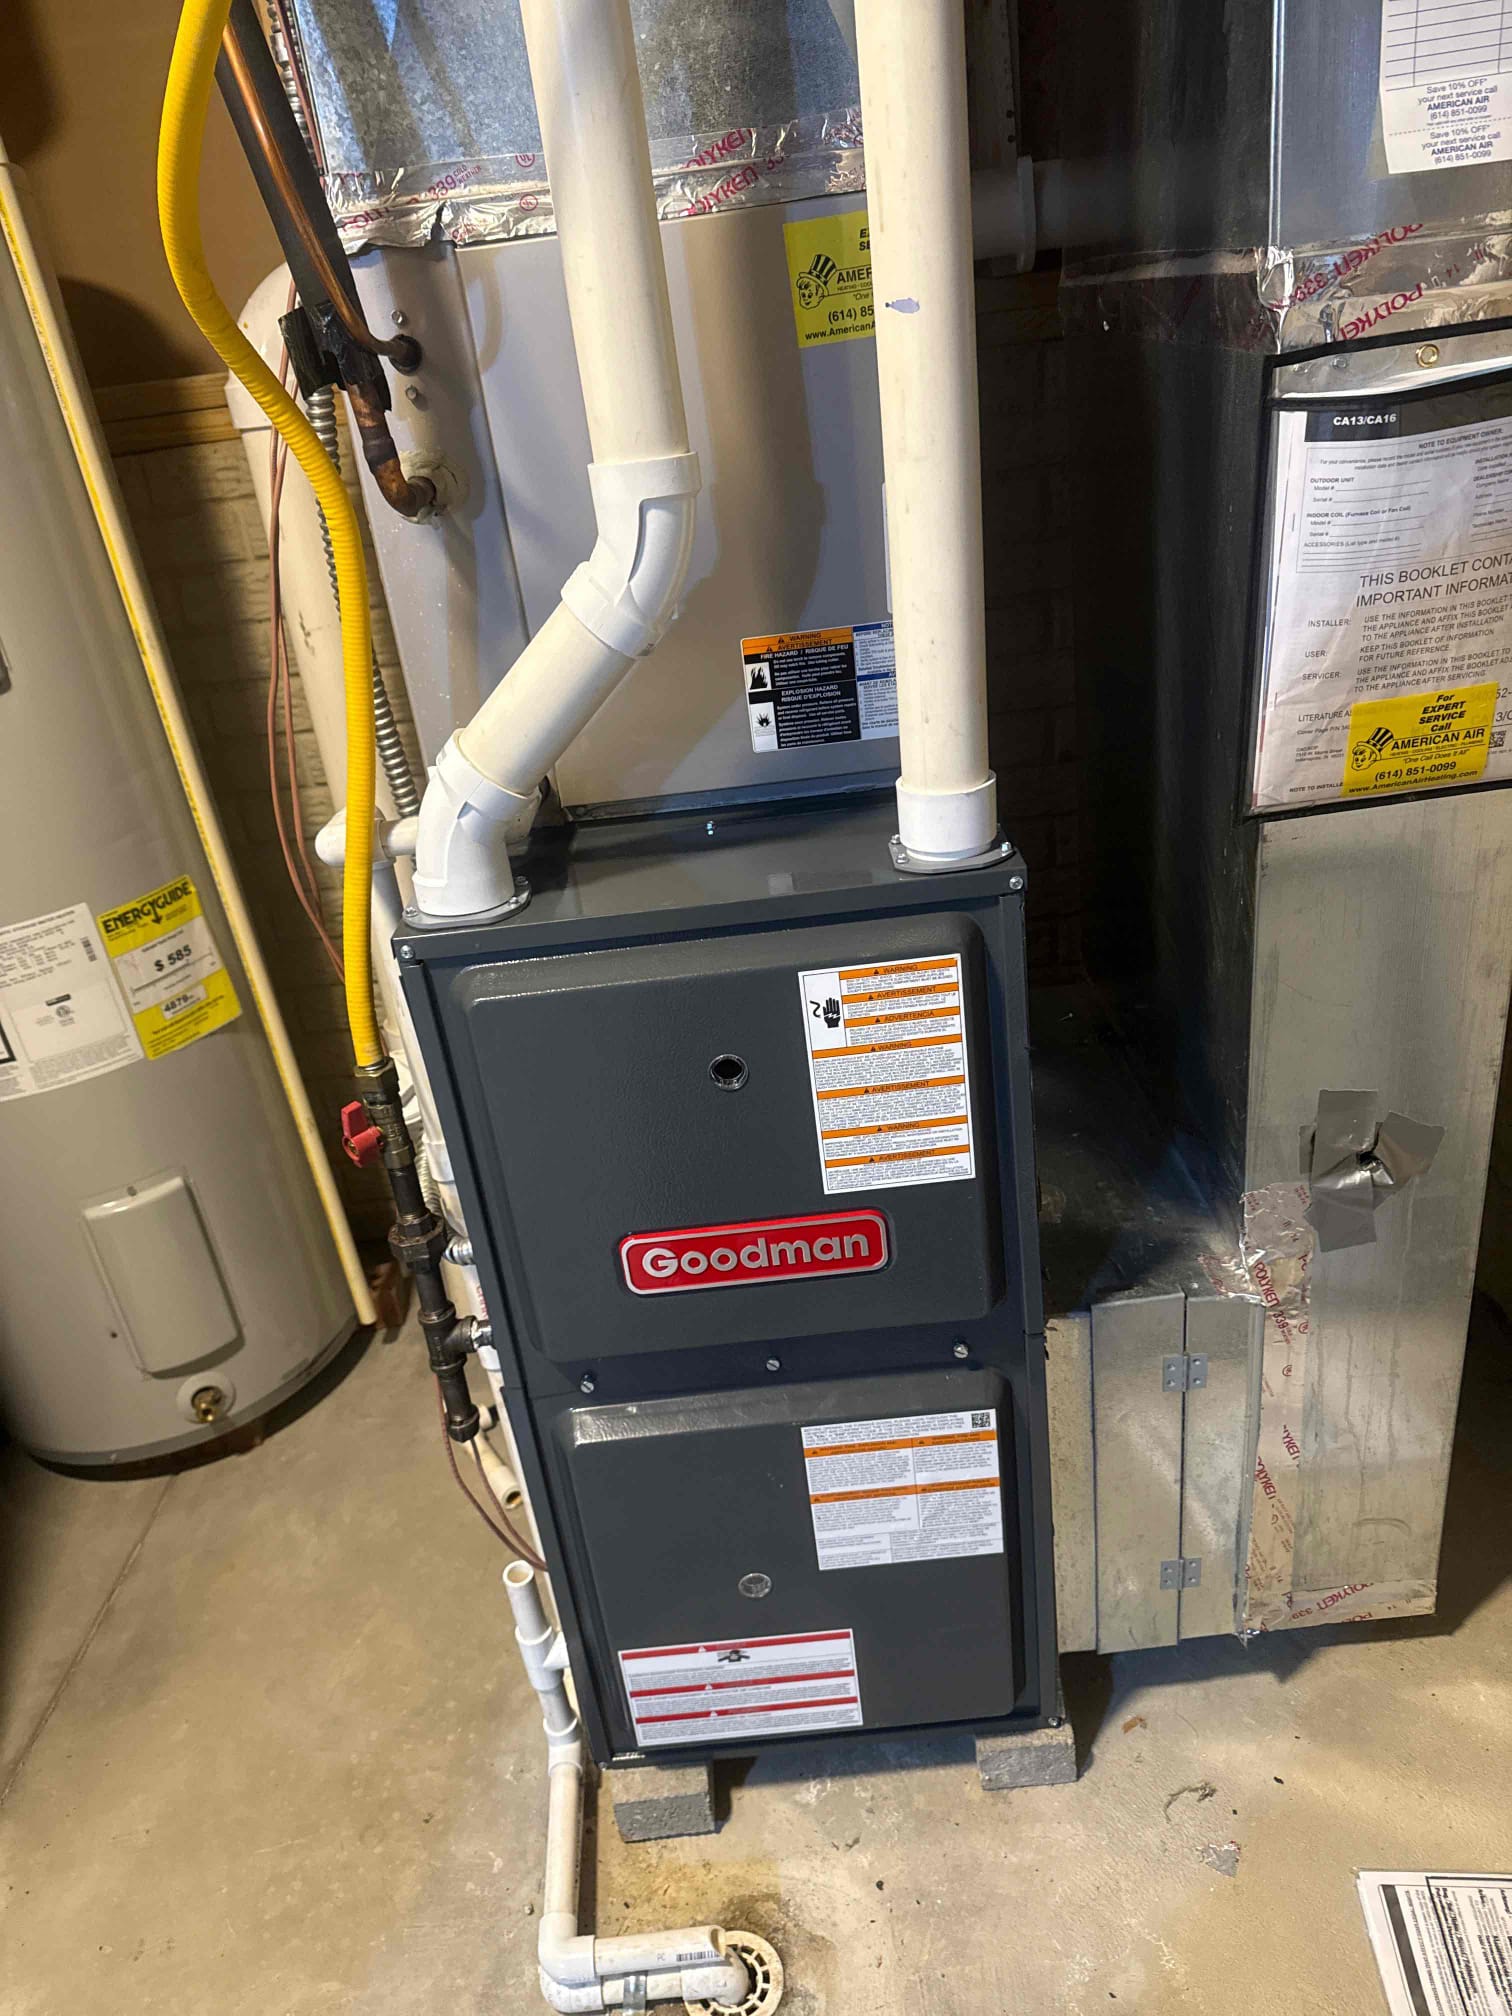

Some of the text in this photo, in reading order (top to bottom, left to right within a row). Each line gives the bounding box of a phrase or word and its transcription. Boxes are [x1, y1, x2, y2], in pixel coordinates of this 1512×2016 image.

[1418, 96, 1434, 105] your
[1456, 89, 1483, 97] service
[1484, 85, 1498, 93] call
[1427, 86, 1446, 94] Save
[1427, 95, 1489, 111] AMERICAN AIR
[1430, 110, 1449, 120] (614)
[1451, 105, 1487, 117] 851-0099
[1421, 142, 1438, 150] your
[1459, 135, 1485, 143] service
[1488, 131, 1501, 139] call
[1432, 144, 1476, 155] AMERICAN
[1434, 150, 1491, 165] (614) 851-0099
[828, 308, 857, 324] (614)
[1333, 413, 1397, 425] CA13/CA16
[1360, 573, 1394, 587] THIS
[1399, 561, 1468, 583] BOOKLET
[1356, 585, 1442, 607] IMPORTANT
[1365, 613, 1380, 623] USE
[1382, 613, 1396, 621] THE
[1398, 606, 1448, 618] INFORMATION
[1459, 602, 1475, 610] THIS
[1476, 595, 1507, 607] BOOKLET
[1308, 618, 1351, 628] INSTALLER:
[1379, 619, 1419, 630] APPLIANCE
[1421, 617, 1436, 625] AND
[1438, 614, 1458, 623] AFFIX
[1460, 612, 1477, 620] THIS
[1478, 605, 1508, 617] BOOKLET
[1362, 634, 1371, 642] TO
[1390, 627, 1429, 639] APPLIANCE
[1431, 624, 1455, 633] AFTER
[1457, 615, 1504, 629] INSTALLATION
[790, 633, 821, 641] WARNING
[1360, 645, 1380, 654] KEEP
[1381, 642, 1398, 651] THIS
[1400, 637, 1433, 649] BOOKLET
[1446, 628, 1495, 642] INFORMATION
[778, 639, 832, 651] AVERTISSEMENT
[1305, 650, 1328, 658] USER:
[1359, 654, 1374, 662] FOR
[1376, 650, 1404, 660] FUTURE
[1357, 668, 1372, 676] USE
[1390, 659, 1438, 671] INFORMATION
[1450, 654, 1466, 662] THIS
[1468, 649, 1500, 660] BOOKLET
[1302, 671, 1342, 681] SERVICER:
[1356, 676, 1370, 684] THE
[1371, 671, 1411, 683] APPLIANCE
[1412, 669, 1427, 677] AND
[1429, 666, 1450, 675] AFFIX
[1451, 664, 1465, 672] THE
[1467, 658, 1498, 669] BOOKLET
[1354, 685, 1364, 693] TO
[1381, 678, 1420, 690] APPLIANCE
[1421, 676, 1446, 685] AFTER
[1447, 671, 1486, 681] SERVICING
[781, 688, 813, 696] EXPLOSION
[1422, 701, 1466, 715] EXPERT
[1298, 711, 1343, 722] LITERATURE
[1419, 711, 1466, 725] SERVICE
[1431, 722, 1452, 732] Call
[1391, 728, 1485, 750] AMERICAN AIR
[1375, 761, 1456, 782] (614) 851-0099
[1349, 769, 1478, 793] www.AmericanAirHeating.com
[102, 881, 192, 934] ENERGYGUIDE
[154, 944, 192, 972] $ 585
[883, 964, 918, 973] WARNING
[877, 986, 936, 999] AVERTISSEMENT
[885, 1011, 934, 1021] ADVERTENCIA
[878, 1041, 912, 1050] WARNING
[872, 1081, 930, 1093] AVERTISSEMENT
[887, 1122, 920, 1131] WARNING
[879, 1150, 935, 1161] AVERTISSEMENT
[641, 1233, 870, 1278] Goodman
[1254, 1261, 1280, 1308] POLYKEN
